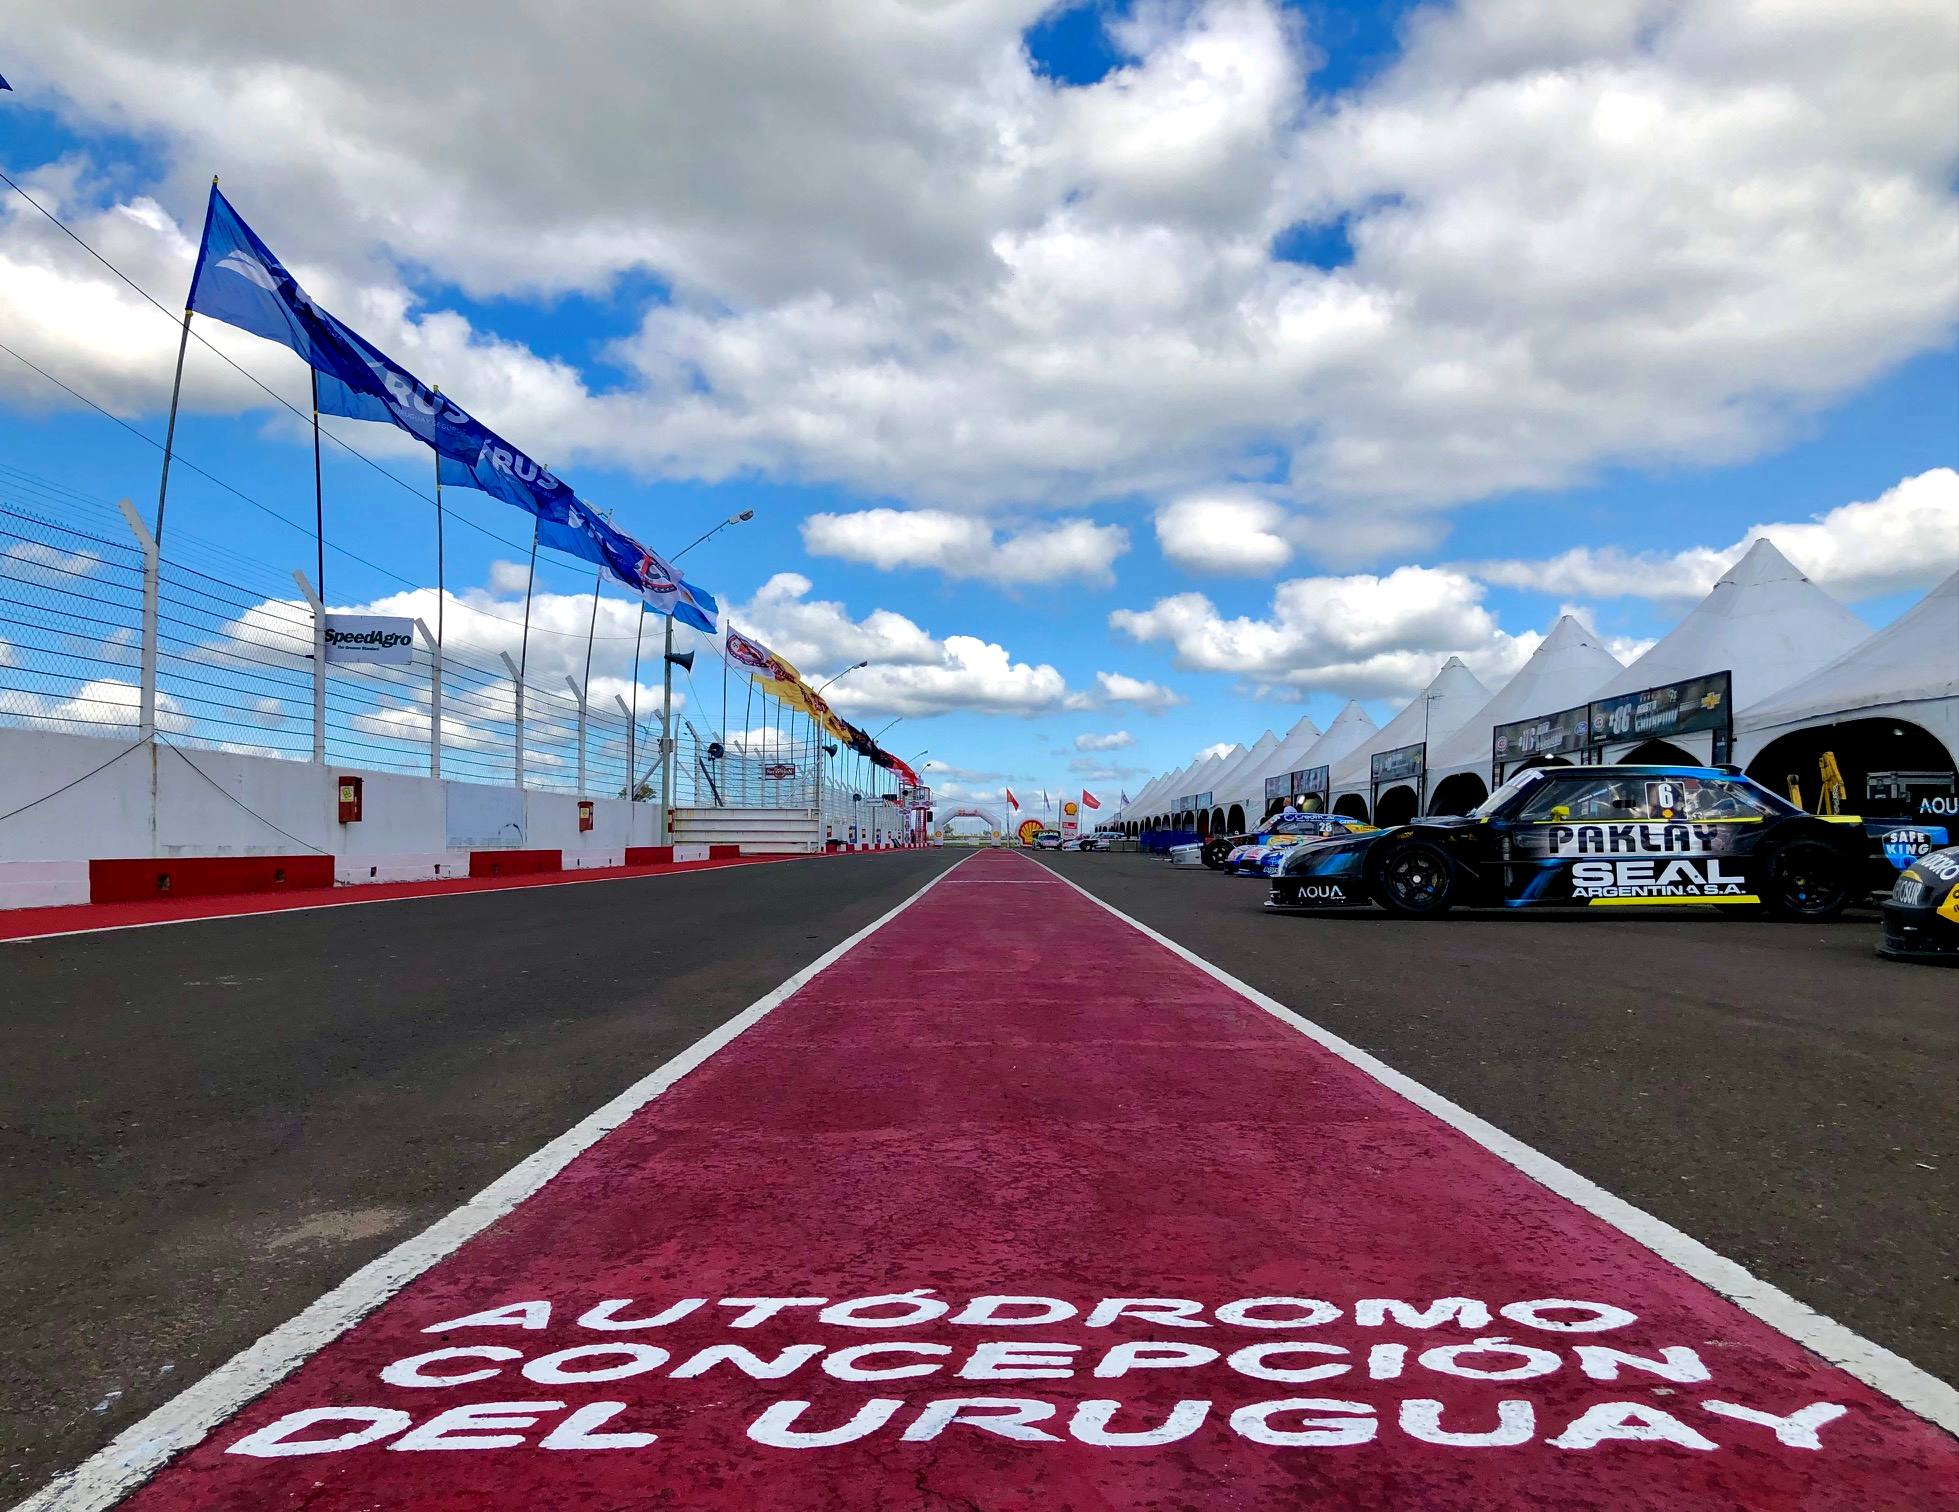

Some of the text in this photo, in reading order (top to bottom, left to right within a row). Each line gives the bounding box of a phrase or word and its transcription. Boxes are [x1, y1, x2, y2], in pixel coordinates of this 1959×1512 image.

[385, 370, 469, 423] RUS
[492, 446, 559, 490] RUS
[325, 629, 411, 647] SpeedAgro
[1658, 784, 1673, 808] 6
[1886, 843, 1930, 855] KING
[1889, 830, 1925, 843] SAFE
[1572, 859, 1745, 887] SEAL
[1572, 884, 1746, 898] ARGENTINA S.A.
[421, 1289, 1639, 1333] AUTÓDROMO
[379, 1336, 1712, 1388] CONCEPCIÓN
[225, 1397, 1848, 1457] DEL URUGUAY
